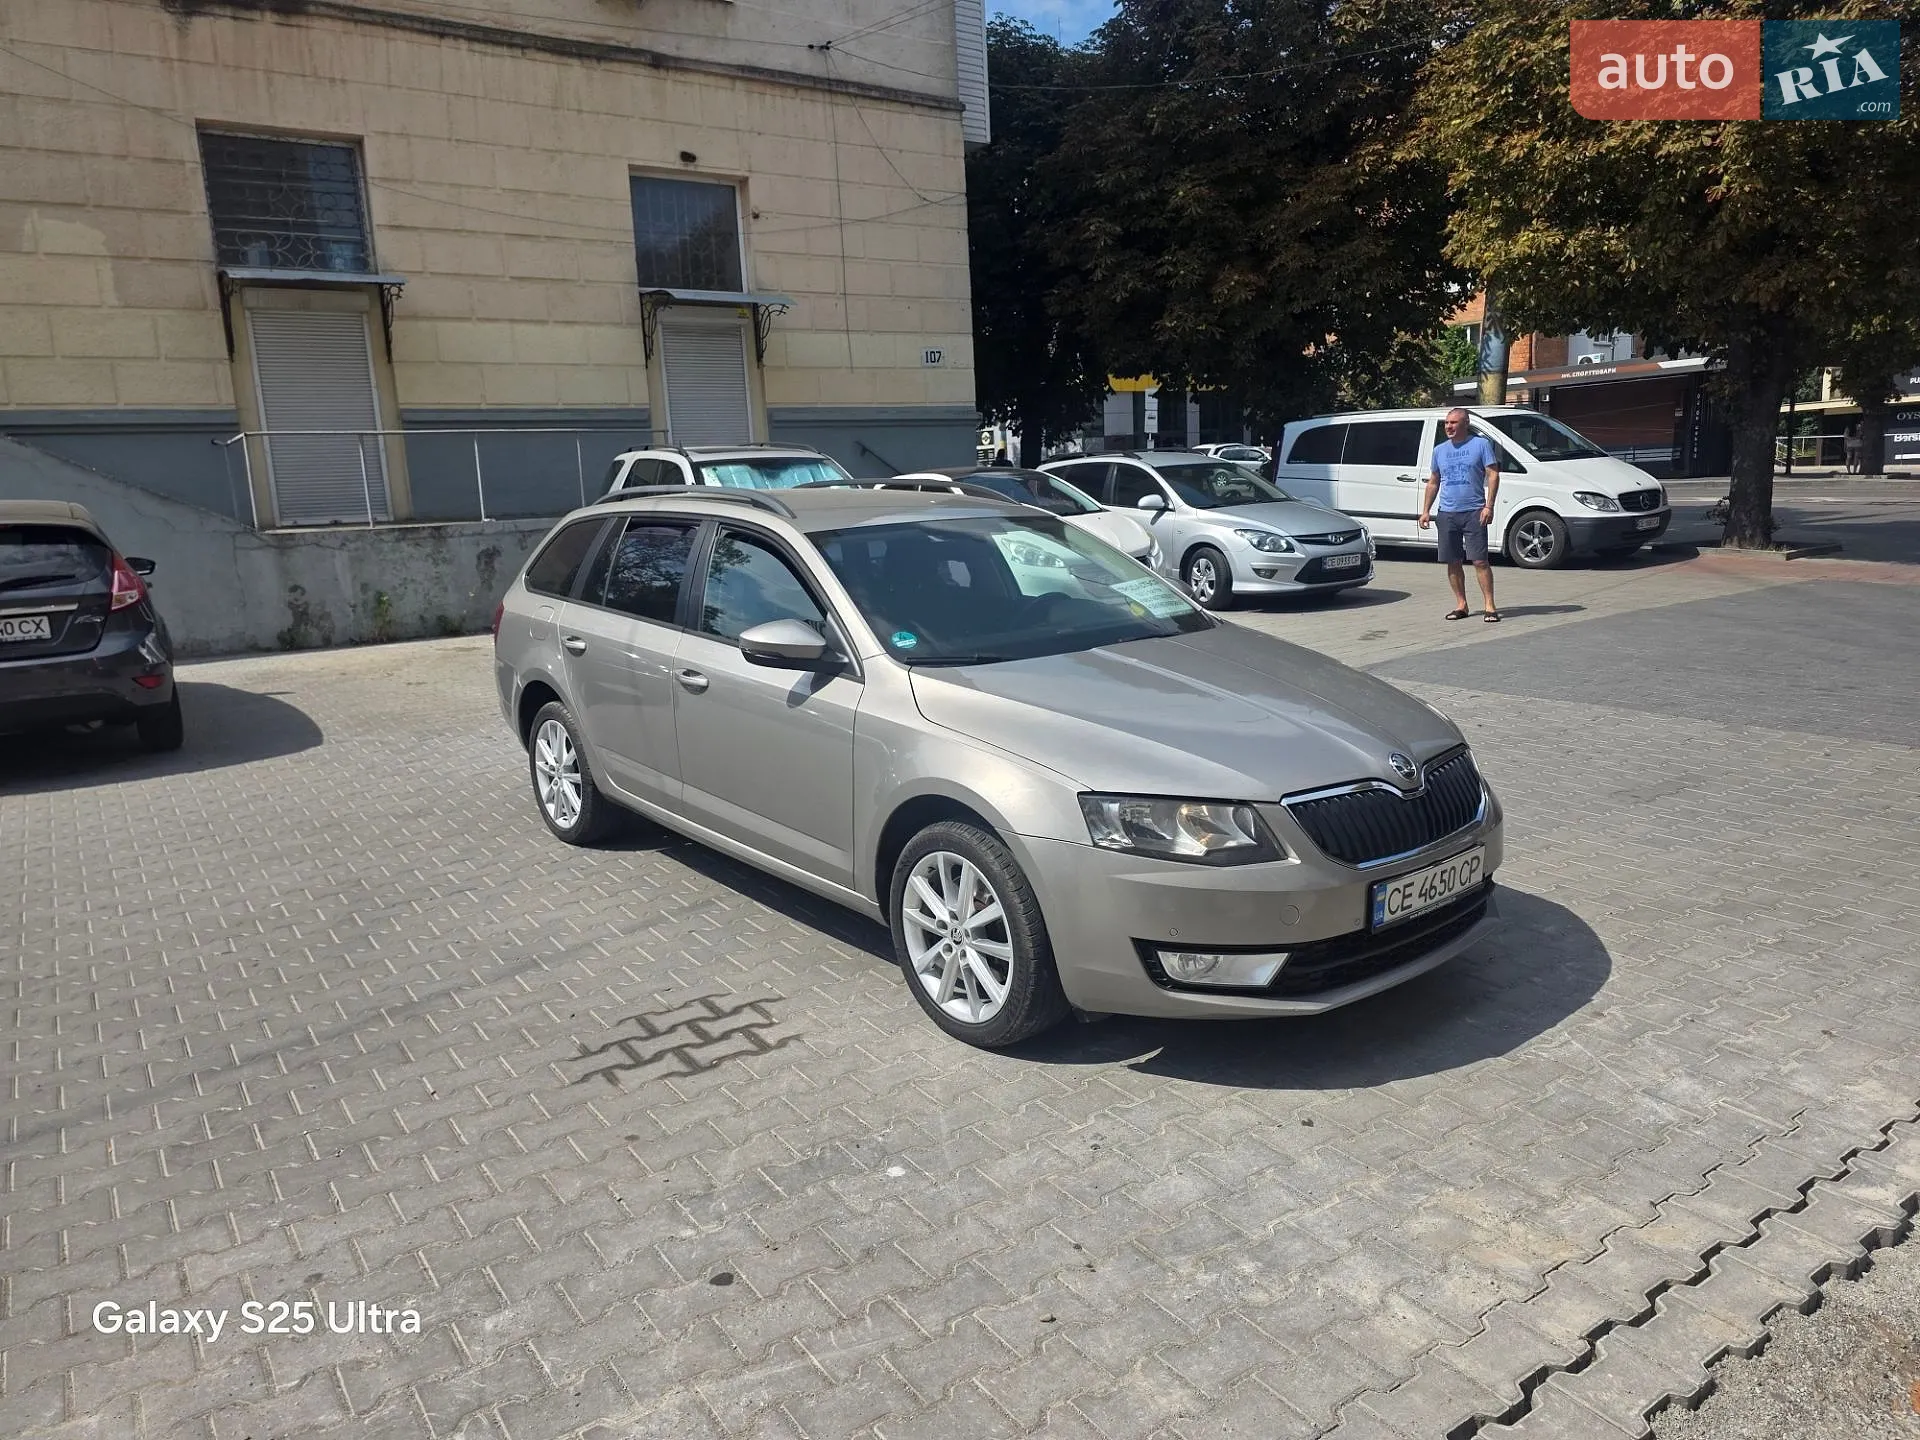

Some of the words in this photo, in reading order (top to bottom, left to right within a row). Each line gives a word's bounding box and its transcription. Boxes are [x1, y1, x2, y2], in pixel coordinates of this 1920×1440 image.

[925, 350, 942, 364] 107
[18, 618, 45, 635] CX
[1387, 881, 1415, 916] CE
[1418, 865, 1457, 903] 4650
[1460, 855, 1480, 887] CP
